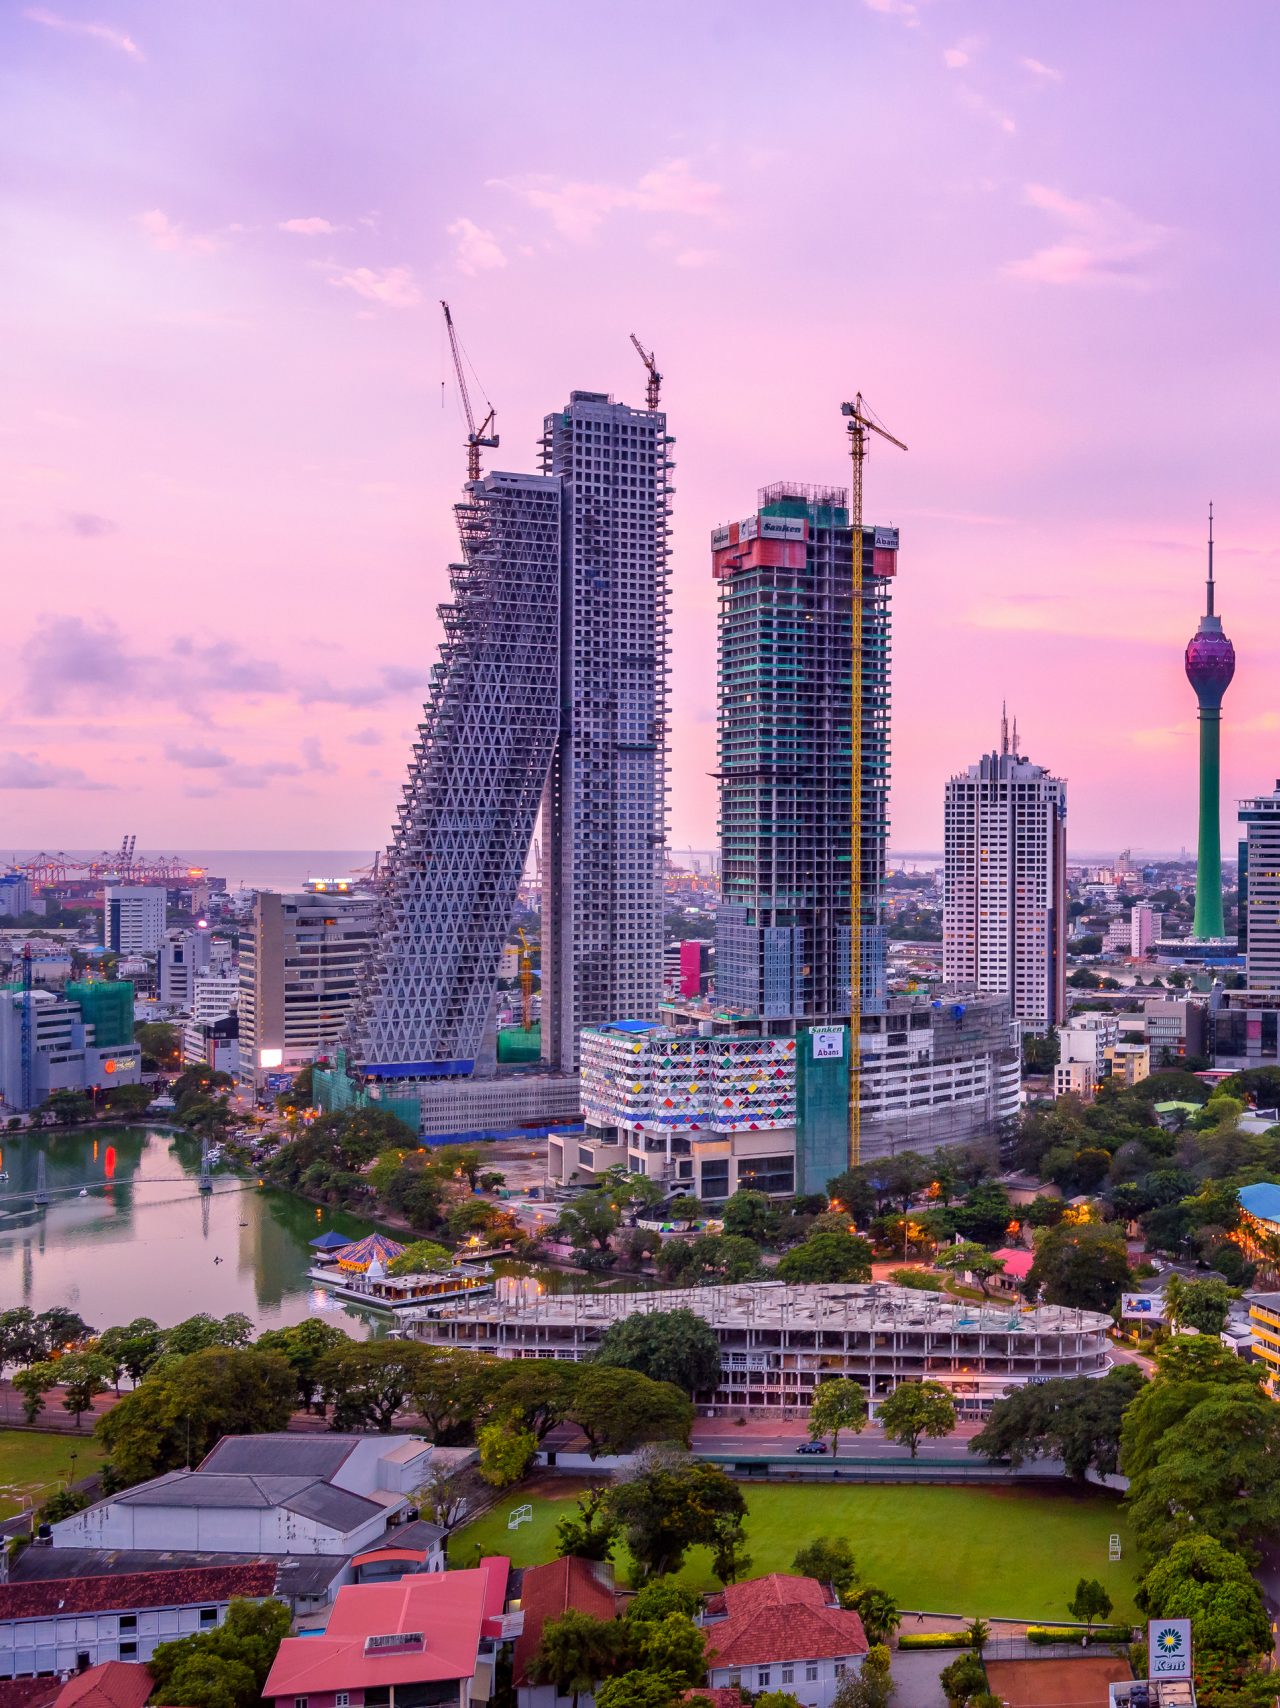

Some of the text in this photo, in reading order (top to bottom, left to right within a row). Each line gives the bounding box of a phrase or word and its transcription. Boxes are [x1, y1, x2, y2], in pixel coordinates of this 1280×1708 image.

[763, 523, 801, 533] Sanken
[811, 1026, 842, 1034] Sanken
[1154, 1660, 1186, 1672] Kent
